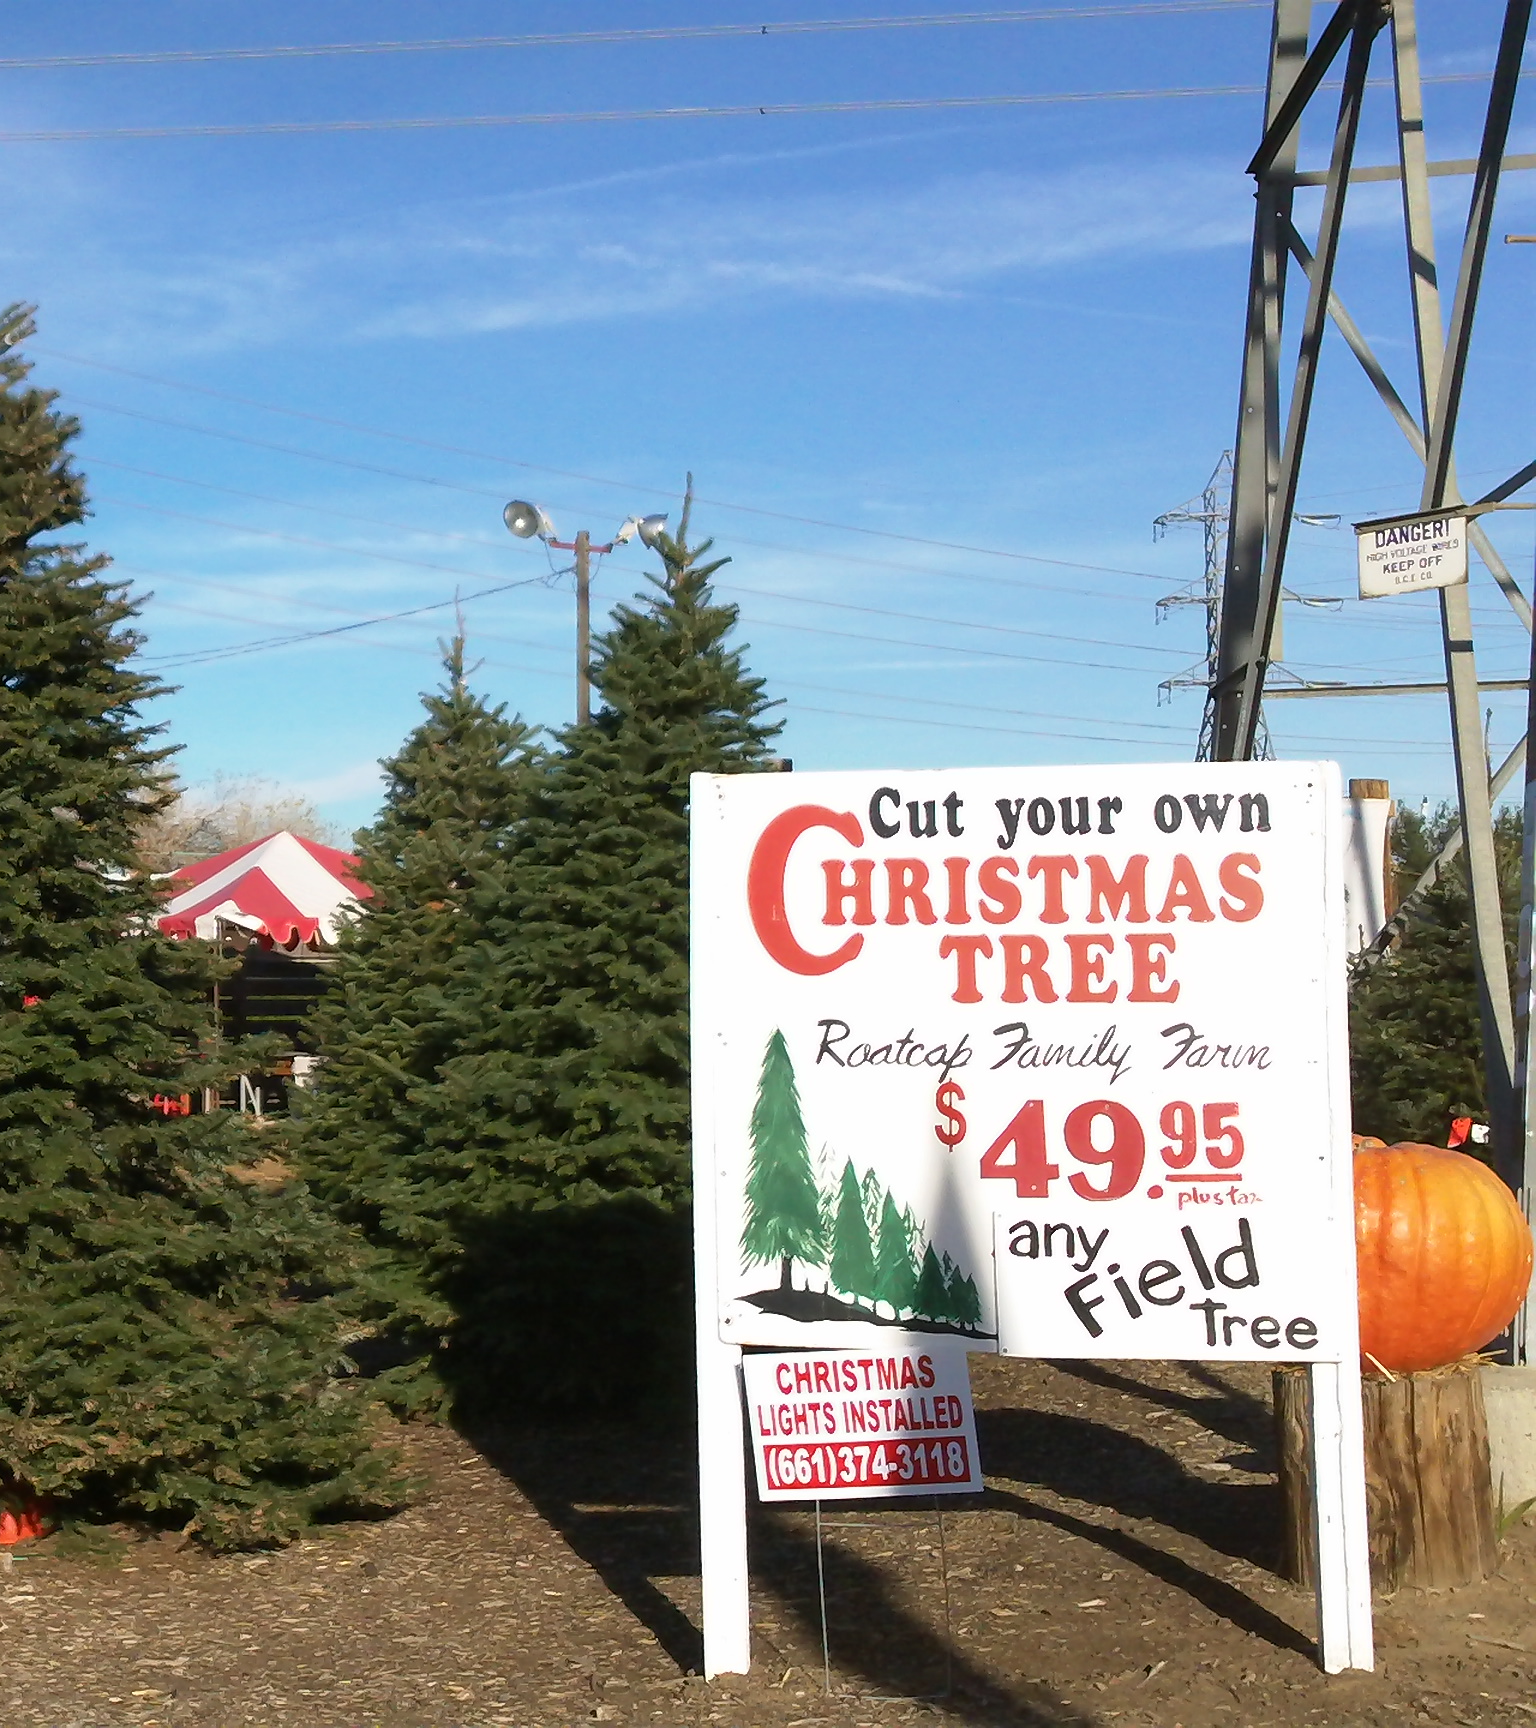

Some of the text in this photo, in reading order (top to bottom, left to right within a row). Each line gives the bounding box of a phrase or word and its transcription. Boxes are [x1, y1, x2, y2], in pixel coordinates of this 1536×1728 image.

[1366, 551, 1389, 563] HIGH
[1390, 544, 1428, 559] VOLTAGE
[1382, 555, 1443, 575] KEEP OFF
[868, 787, 1272, 851] Cut your own
[747, 803, 1264, 976] CHRISTMAS
[939, 932, 1181, 1004] TREE
[816, 1018, 1273, 1085] Roatcap Family Farm
[1178, 1186, 1224, 1211] plus
[1009, 1219, 1110, 1267] any
[1064, 1218, 1260, 1339] Field
[1189, 1297, 1319, 1350] Tree
[775, 1354, 936, 1395] CHRISTMAS
[757, 1395, 963, 1437] LIGHTS INSTALLED
[768, 1440, 965, 1487] (661)374-3118
